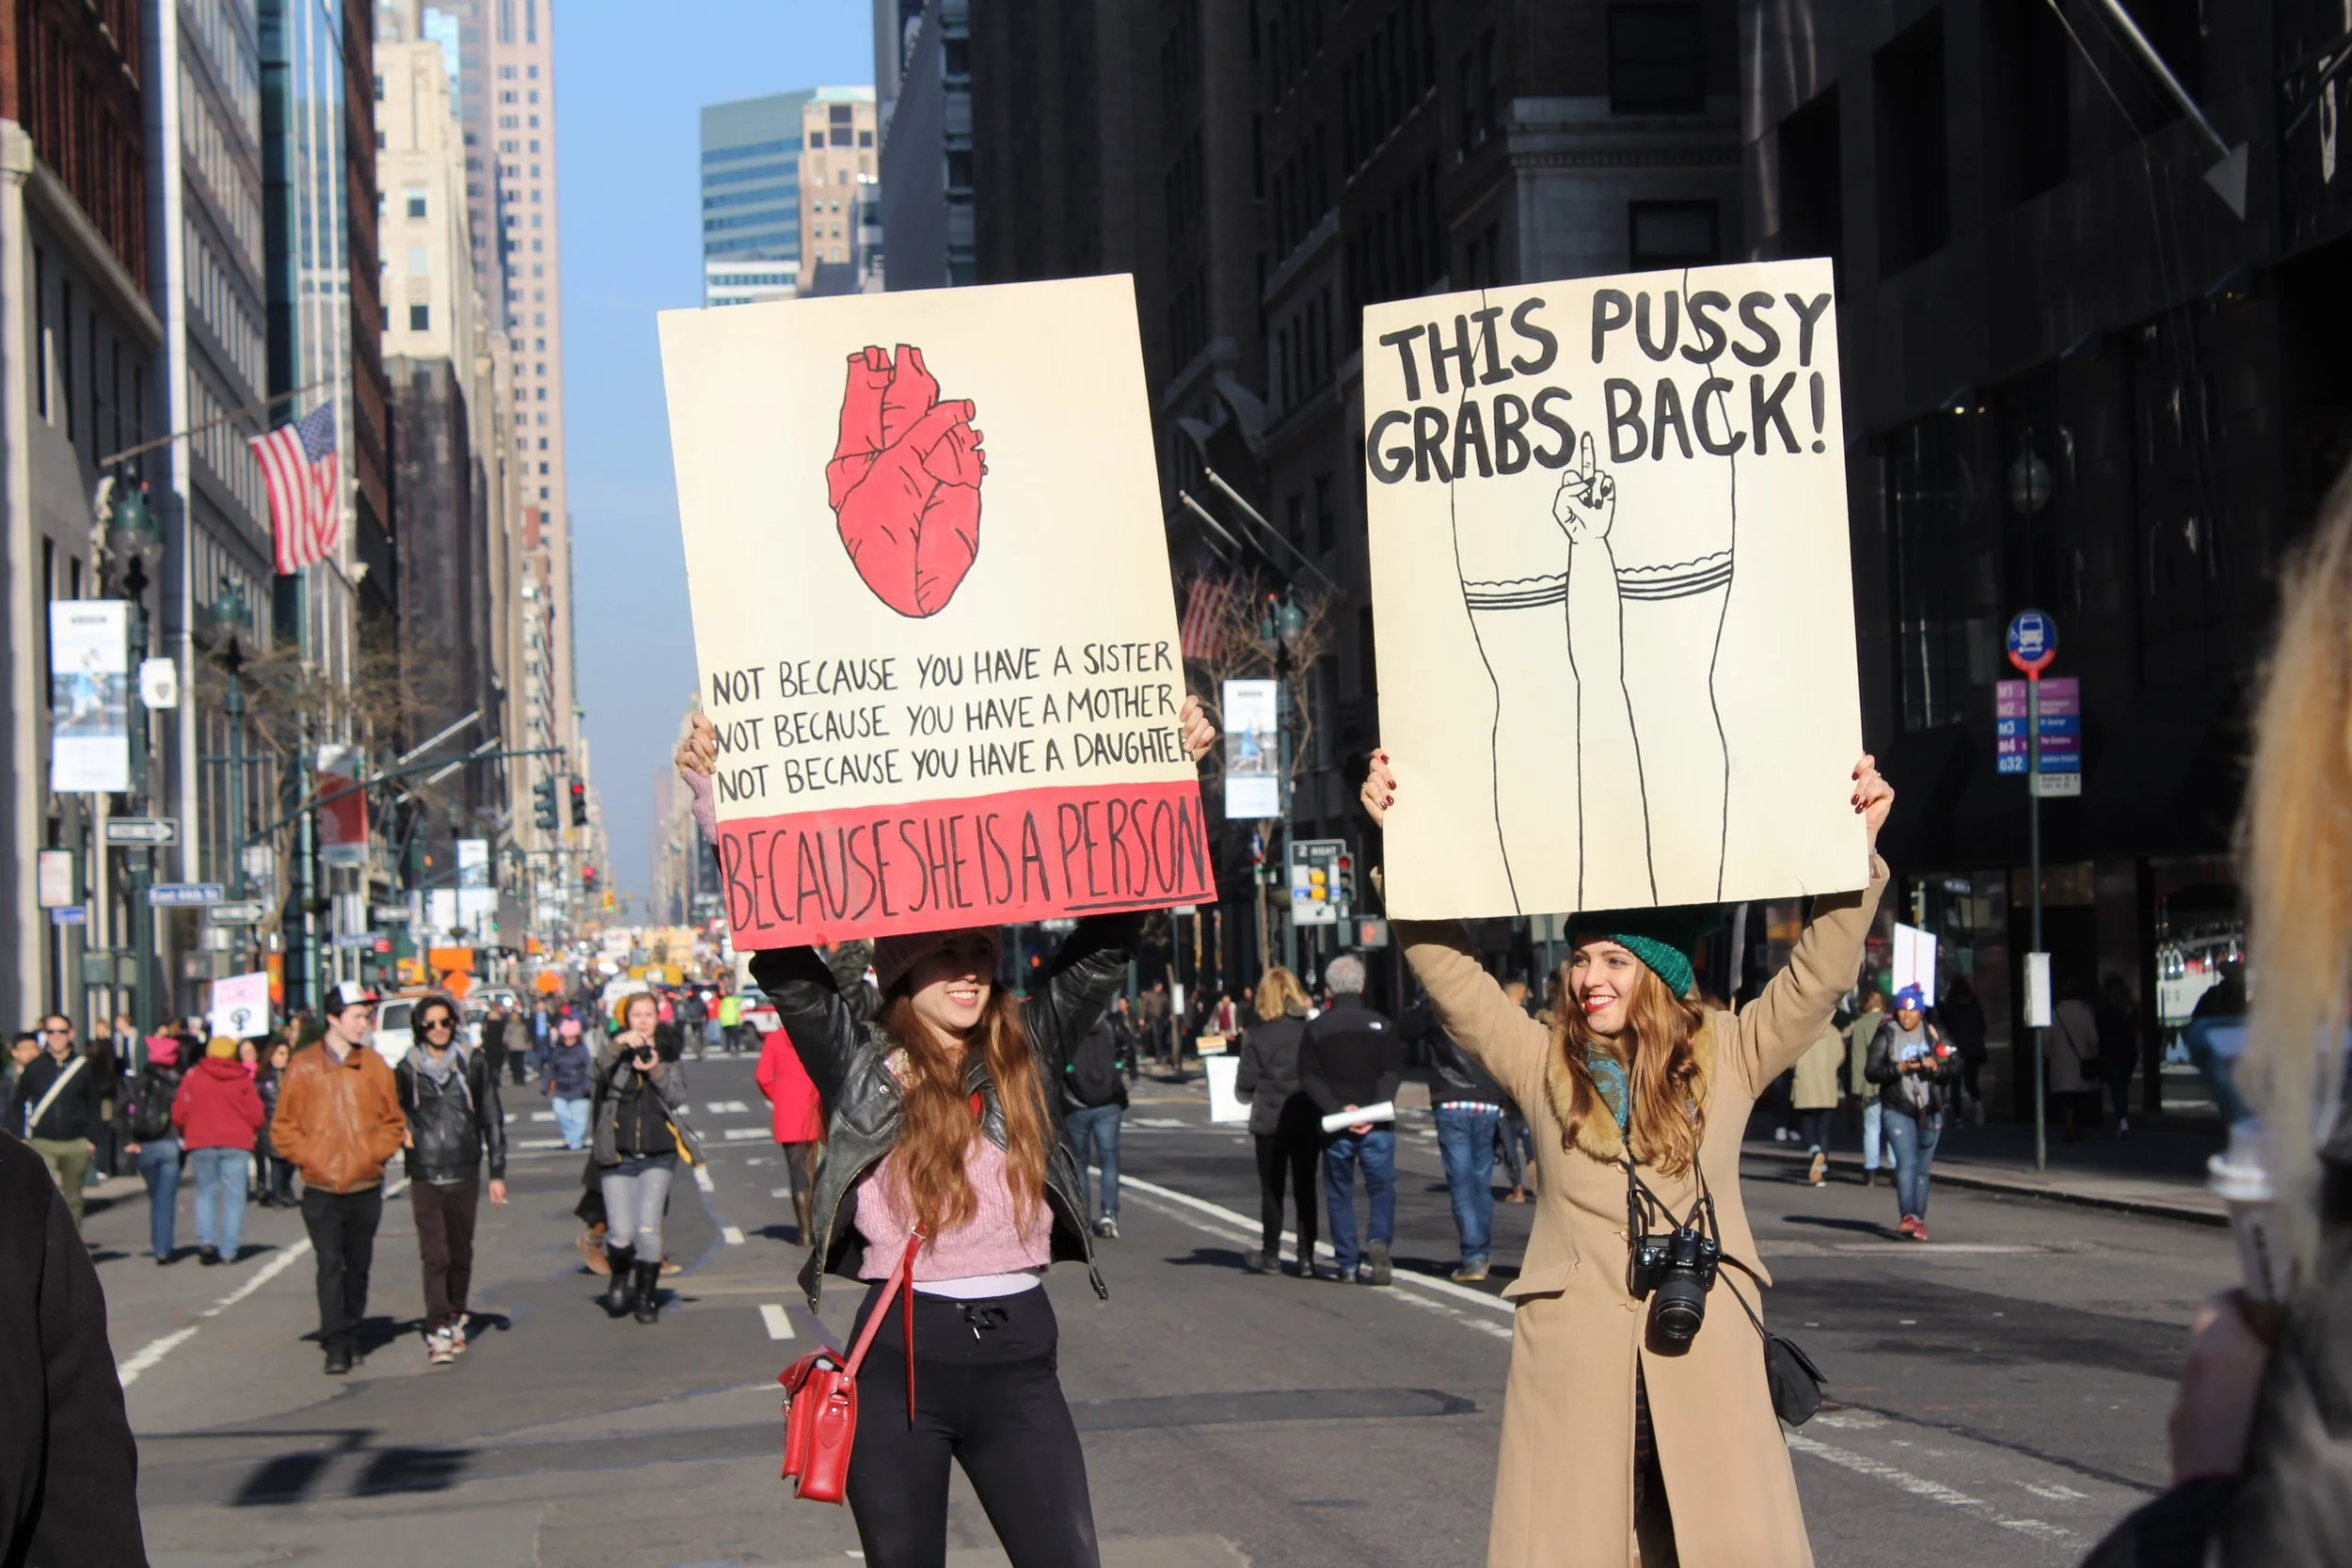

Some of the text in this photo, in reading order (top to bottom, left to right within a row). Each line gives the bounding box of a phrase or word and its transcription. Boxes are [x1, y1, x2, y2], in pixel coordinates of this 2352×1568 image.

[1379, 289, 1833, 402] THIS PUSSY
[1367, 371, 1826, 484] GRABS BACK!
[712, 641, 1173, 706] NOT BECAUSE YOU HAVE A SISTER
[714, 684, 1176, 756] NOT BECAUSE YOU HAVE A MOTHER
[1998, 720, 2015, 735] M3
[1998, 737, 2016, 753] M4
[718, 765, 769, 803] NOT
[785, 749, 902, 794] BECAUSE
[911, 749, 958, 779] YOU
[969, 739, 1036, 778] HAVE
[1046, 738, 1064, 771] A
[722, 796, 1205, 931] BECAUSE SHE IS A PERSON
[1298, 845, 1308, 857] 2
